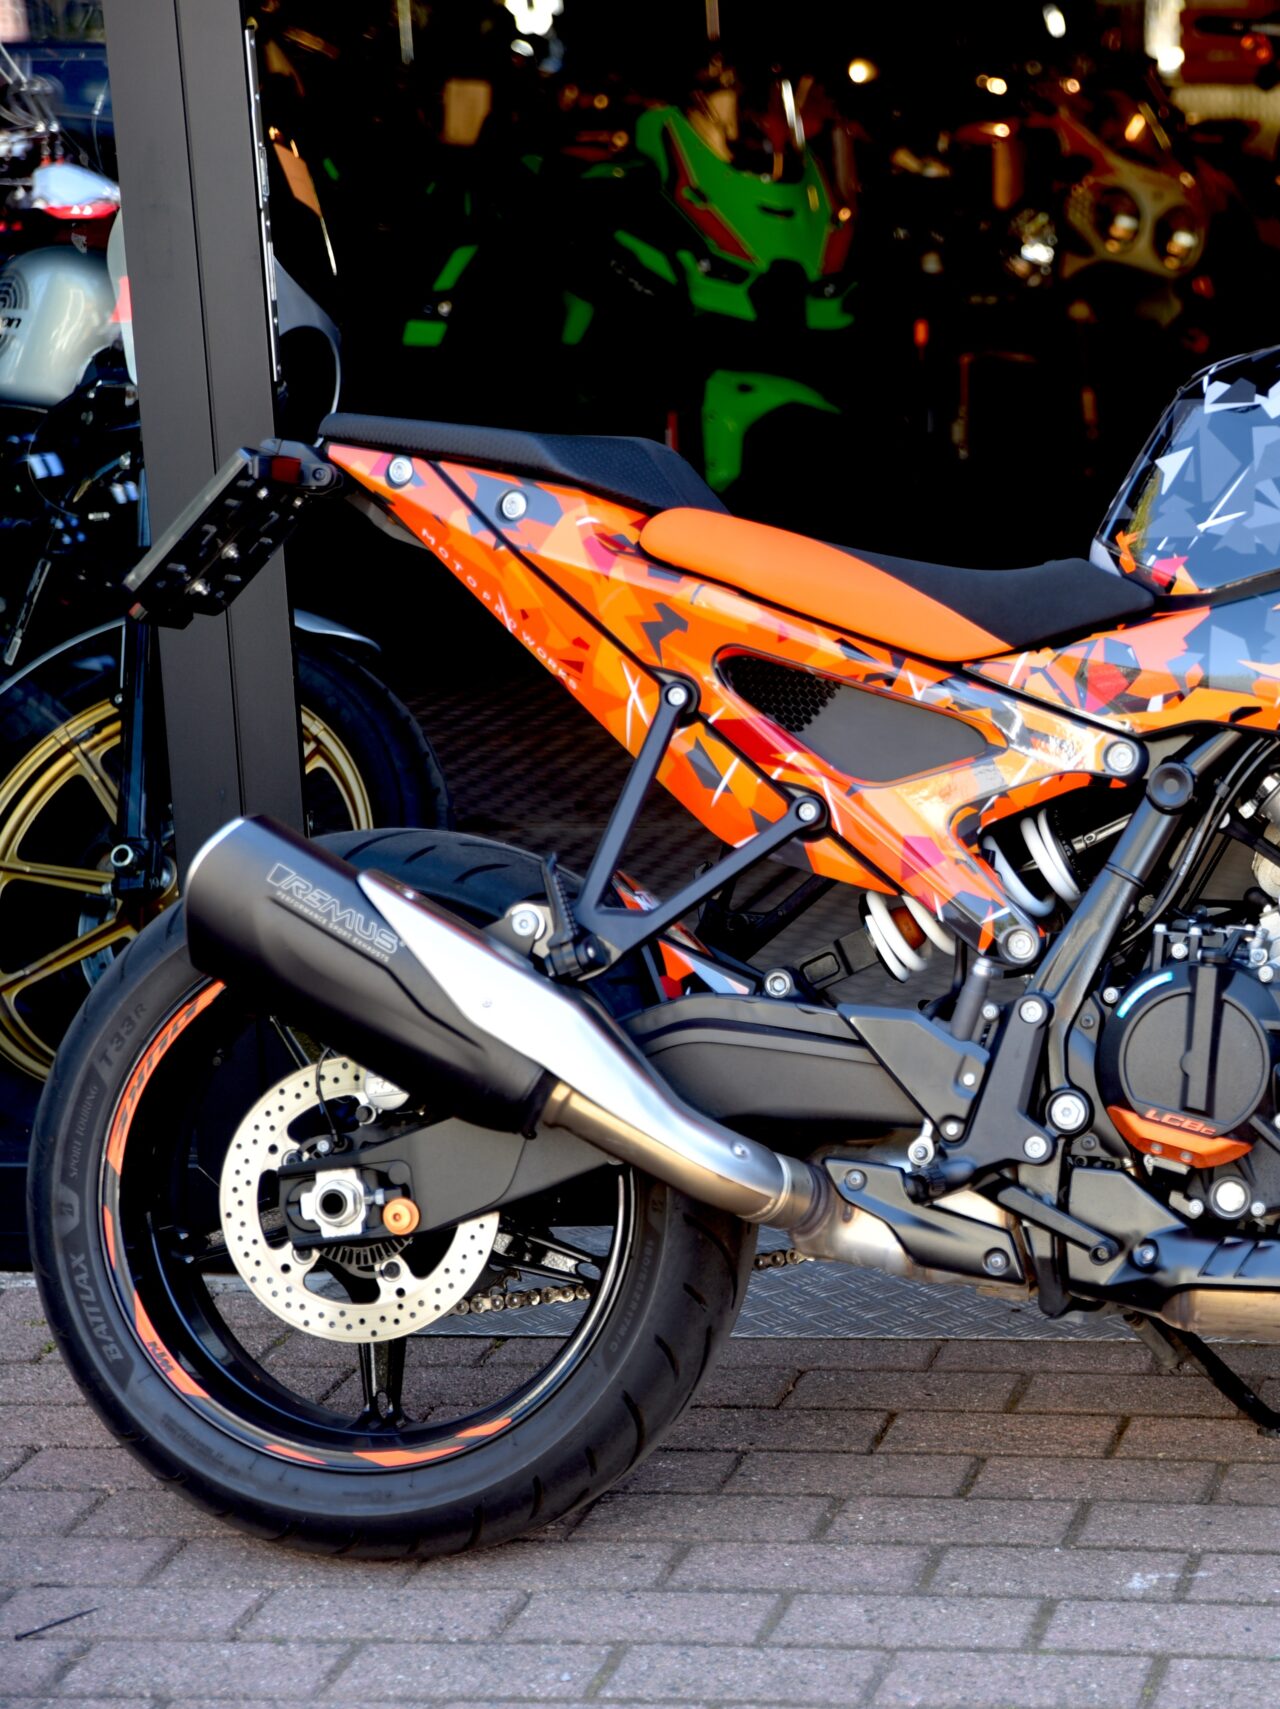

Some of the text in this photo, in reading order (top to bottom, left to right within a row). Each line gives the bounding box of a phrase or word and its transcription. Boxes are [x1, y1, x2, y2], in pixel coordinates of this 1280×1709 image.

[276, 891, 390, 963] PERFORMANCE SPORT EXHAUSTS
[279, 872, 399, 954] REMUS
[69, 1085, 98, 1180] SPORT TOURING
[69, 1252, 125, 1363] BATTLAX
